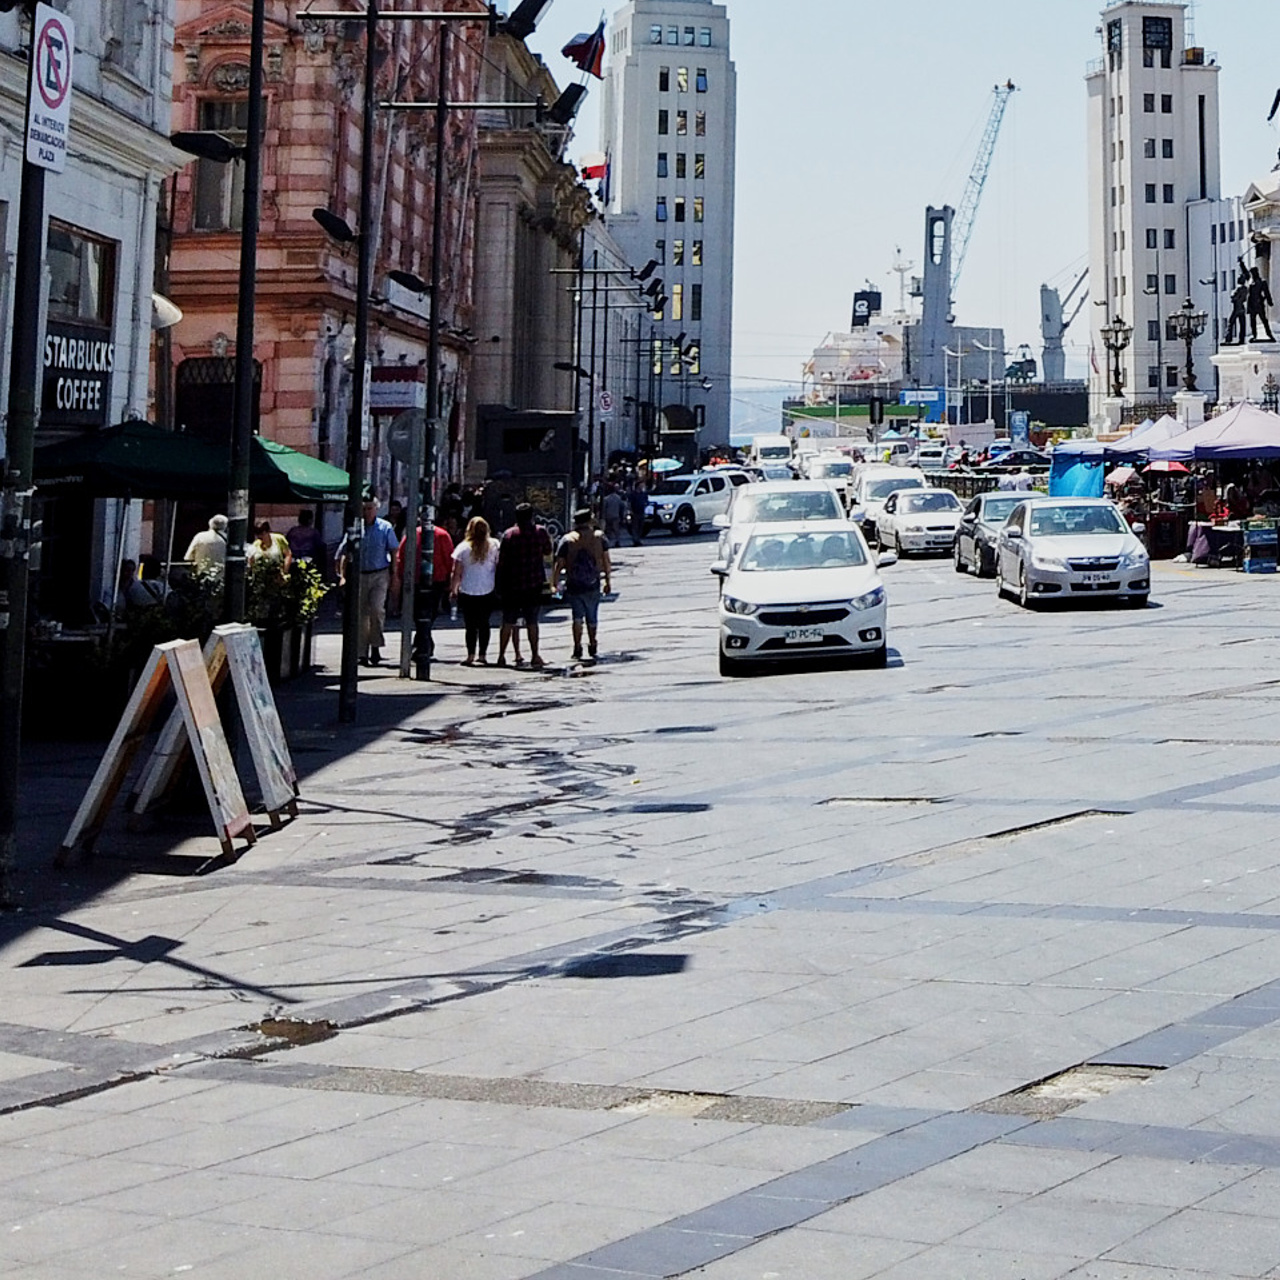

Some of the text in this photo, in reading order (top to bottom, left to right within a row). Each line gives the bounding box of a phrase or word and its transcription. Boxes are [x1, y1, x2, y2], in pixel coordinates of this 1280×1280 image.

[45, 35, 63, 91] E
[44, 334, 115, 374] STARBUCKS
[56, 377, 102, 410] COFFEE
